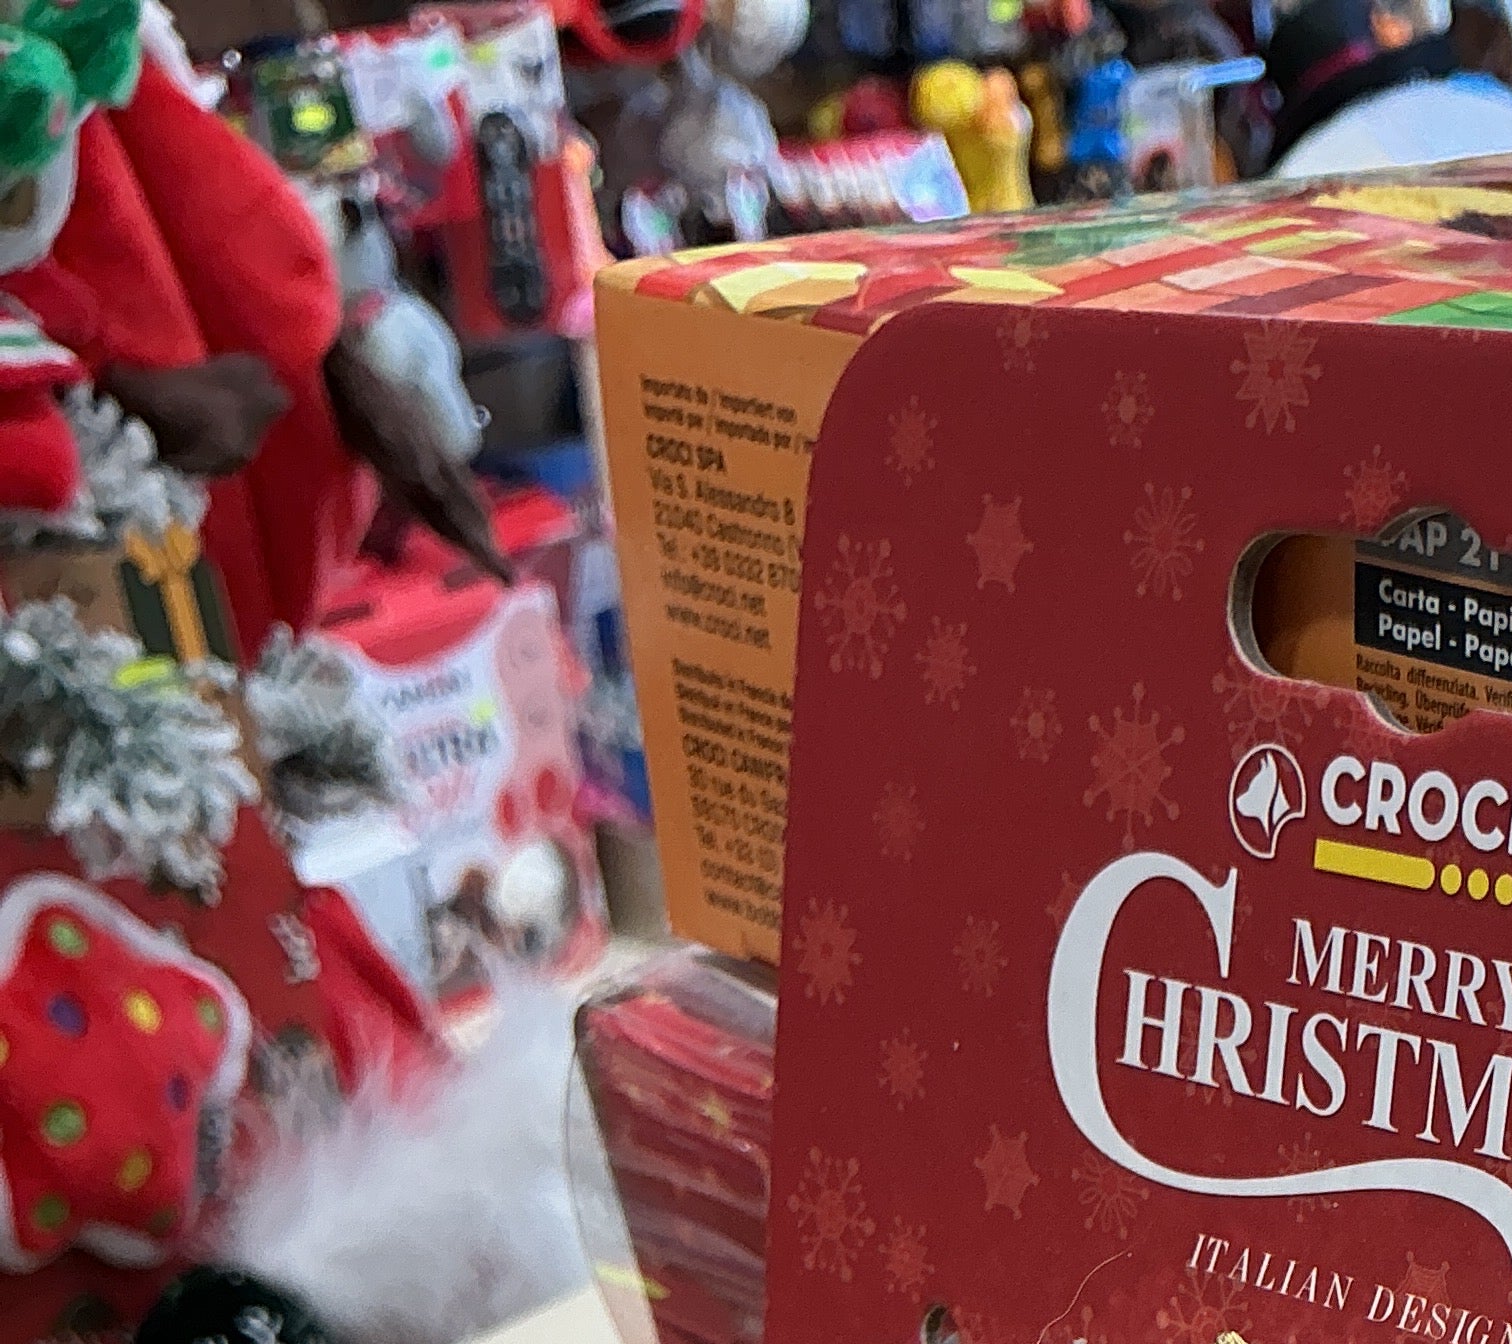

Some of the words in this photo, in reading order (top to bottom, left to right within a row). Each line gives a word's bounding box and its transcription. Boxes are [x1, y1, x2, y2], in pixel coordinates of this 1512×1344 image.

[1378, 578, 1441, 616] Carta
[1378, 612, 1442, 651] Papel
[1356, 653, 1401, 681] Raccolta
[1188, 1232, 1355, 1312] ITALIAN
